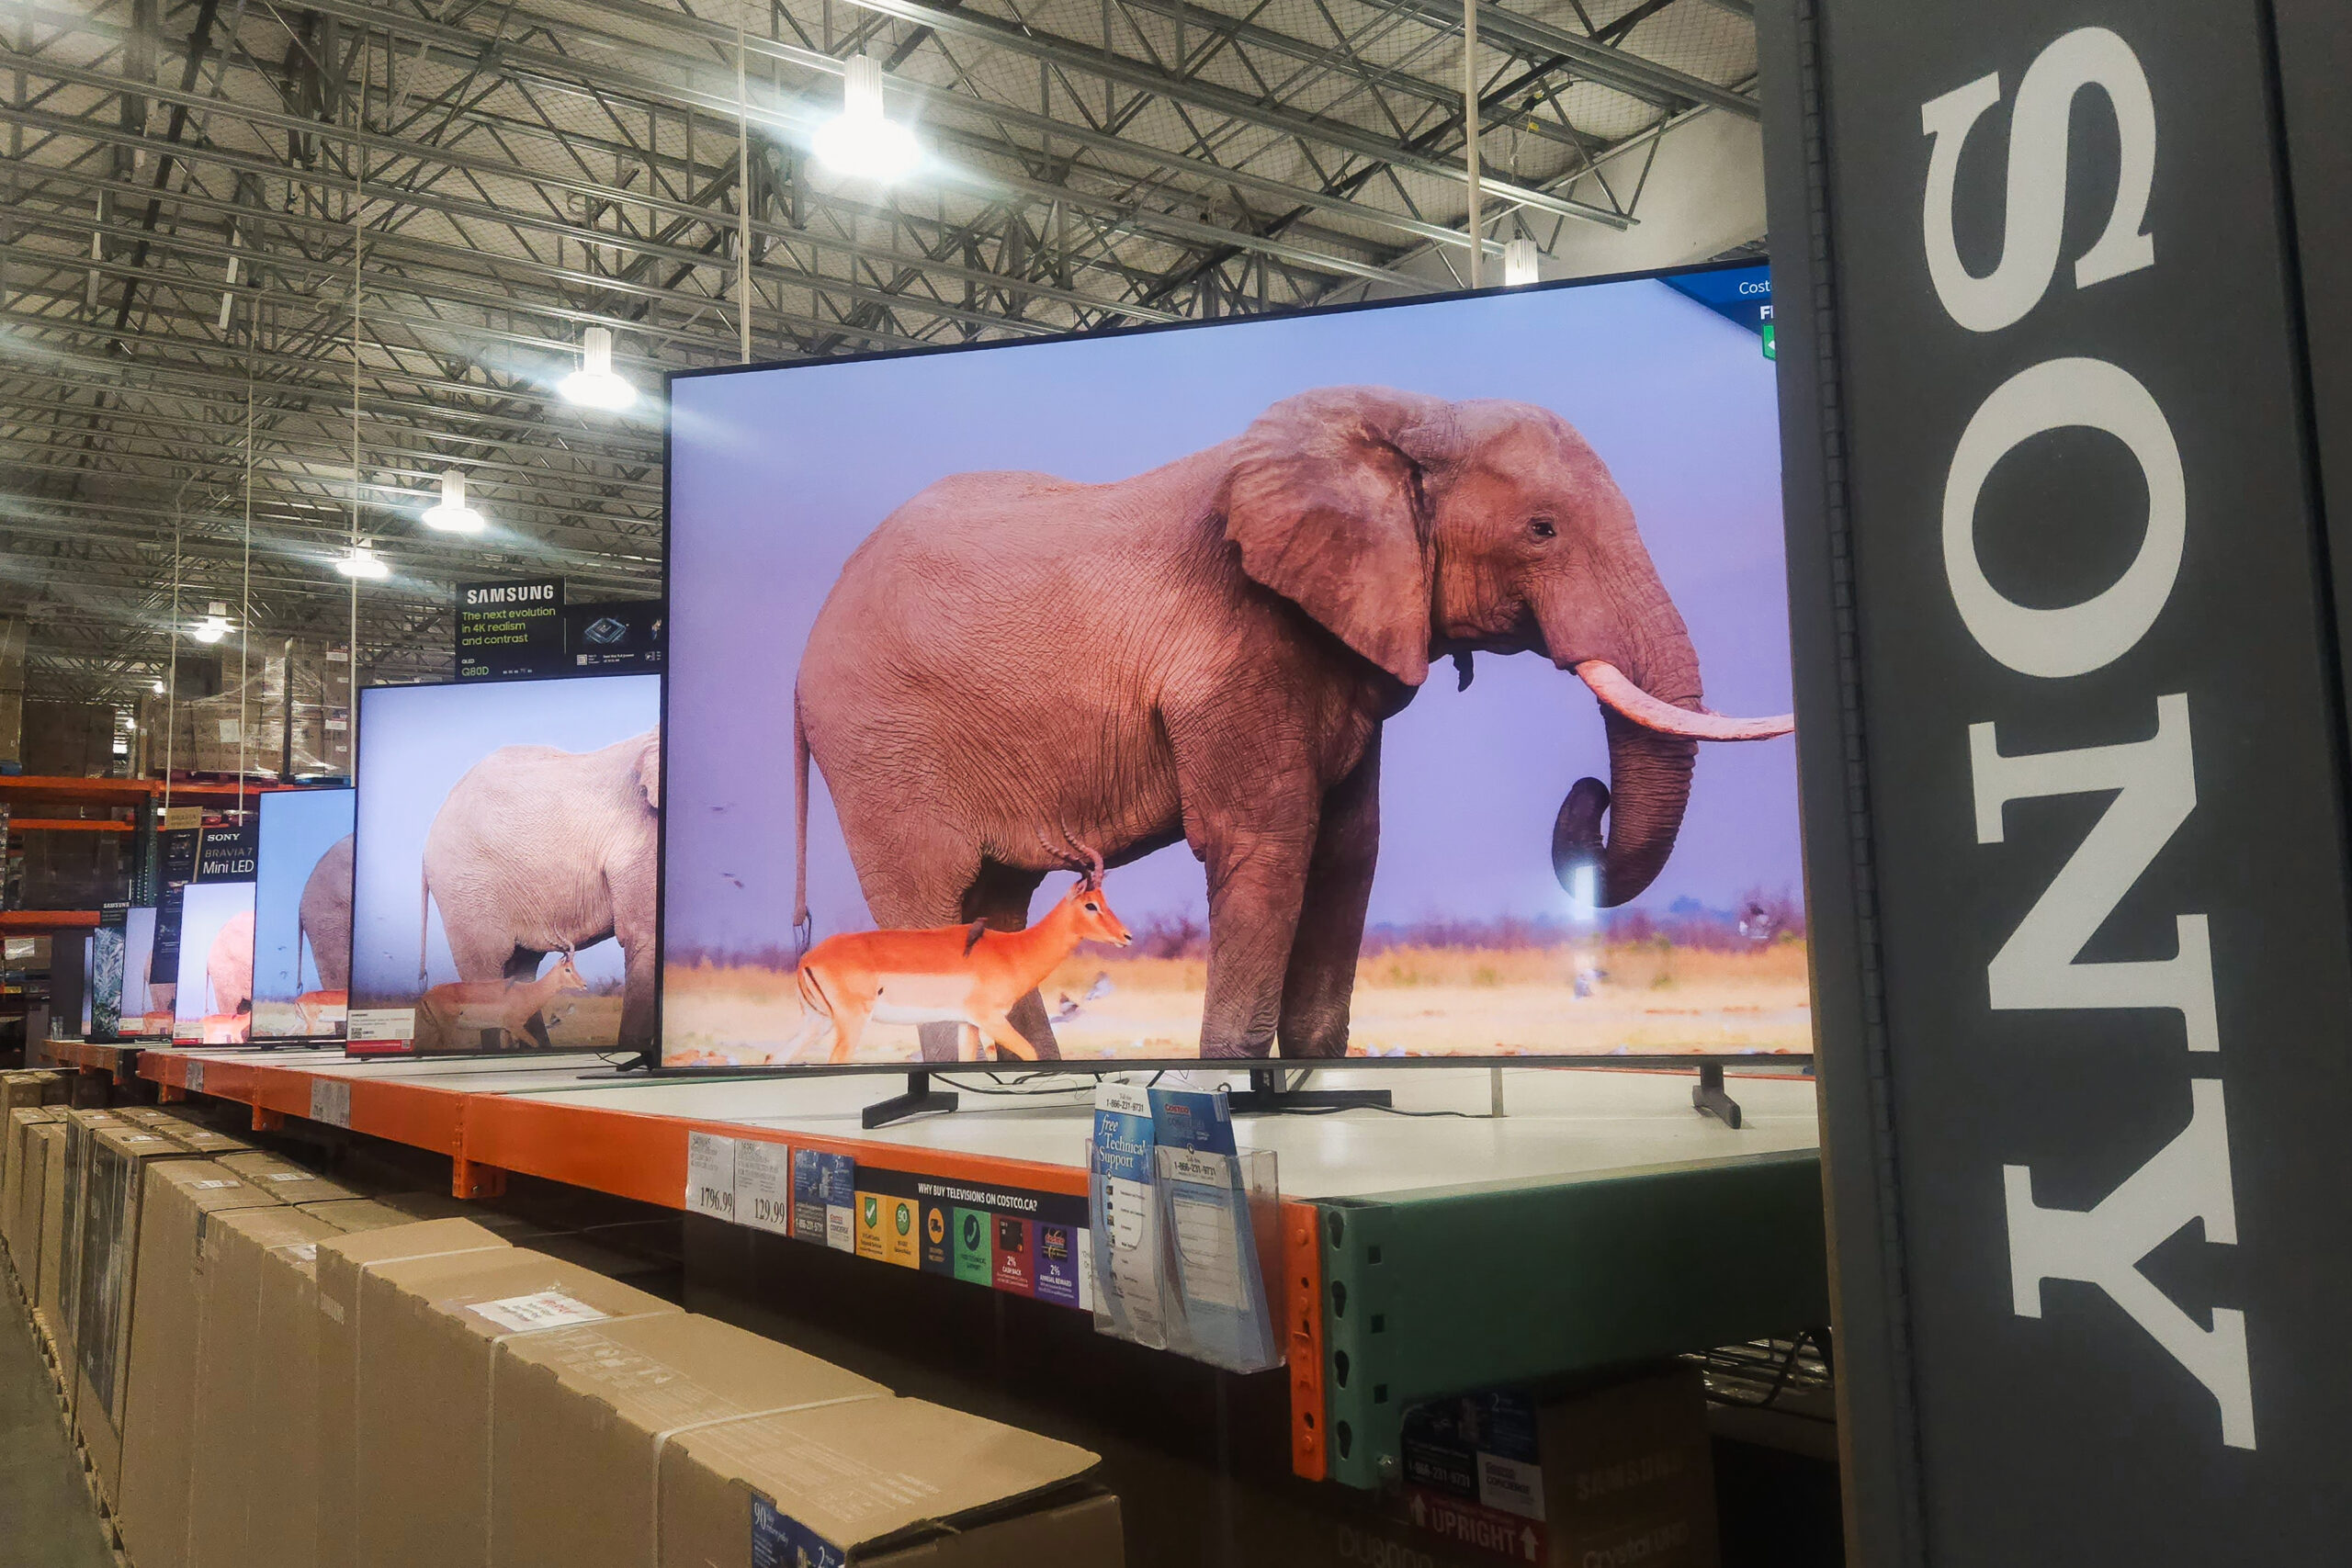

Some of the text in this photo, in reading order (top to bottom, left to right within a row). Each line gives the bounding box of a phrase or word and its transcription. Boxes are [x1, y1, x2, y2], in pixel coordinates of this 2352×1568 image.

[1739, 280, 1771, 294] Cost
[467, 584, 554, 604] SAMSUNG
[462, 606, 556, 621] The next evolution
[462, 621, 526, 634] in 4K realism
[462, 634, 528, 646] and contrast
[461, 666, 490, 677] Q80D
[1921, 26, 2257, 1451] SONY
[207, 833, 241, 841] SONY
[205, 847, 253, 858] BRAVIA 7
[202, 859, 254, 874] Mini LED
[1099, 1114, 1119, 1135] free
[1104, 1132, 1146, 1156] Technical
[1099, 1145, 1134, 1170] Support
[701, 1187, 733, 1213] 1796.99
[755, 1197, 785, 1224] 129.99
[918, 1182, 1038, 1212] WHY BUY TELEVISIONS ON COSTCO.CA?
[897, 1210, 908, 1223] 90
[1007, 1256, 1017, 1267] 2%
[1050, 1265, 1060, 1276] 2%
[1491, 1393, 1500, 1413] 2
[1486, 1476, 1531, 1495] CONCIERGE
[754, 1502, 766, 1530] 90
[1431, 1506, 1517, 1555] UPRIGHT
